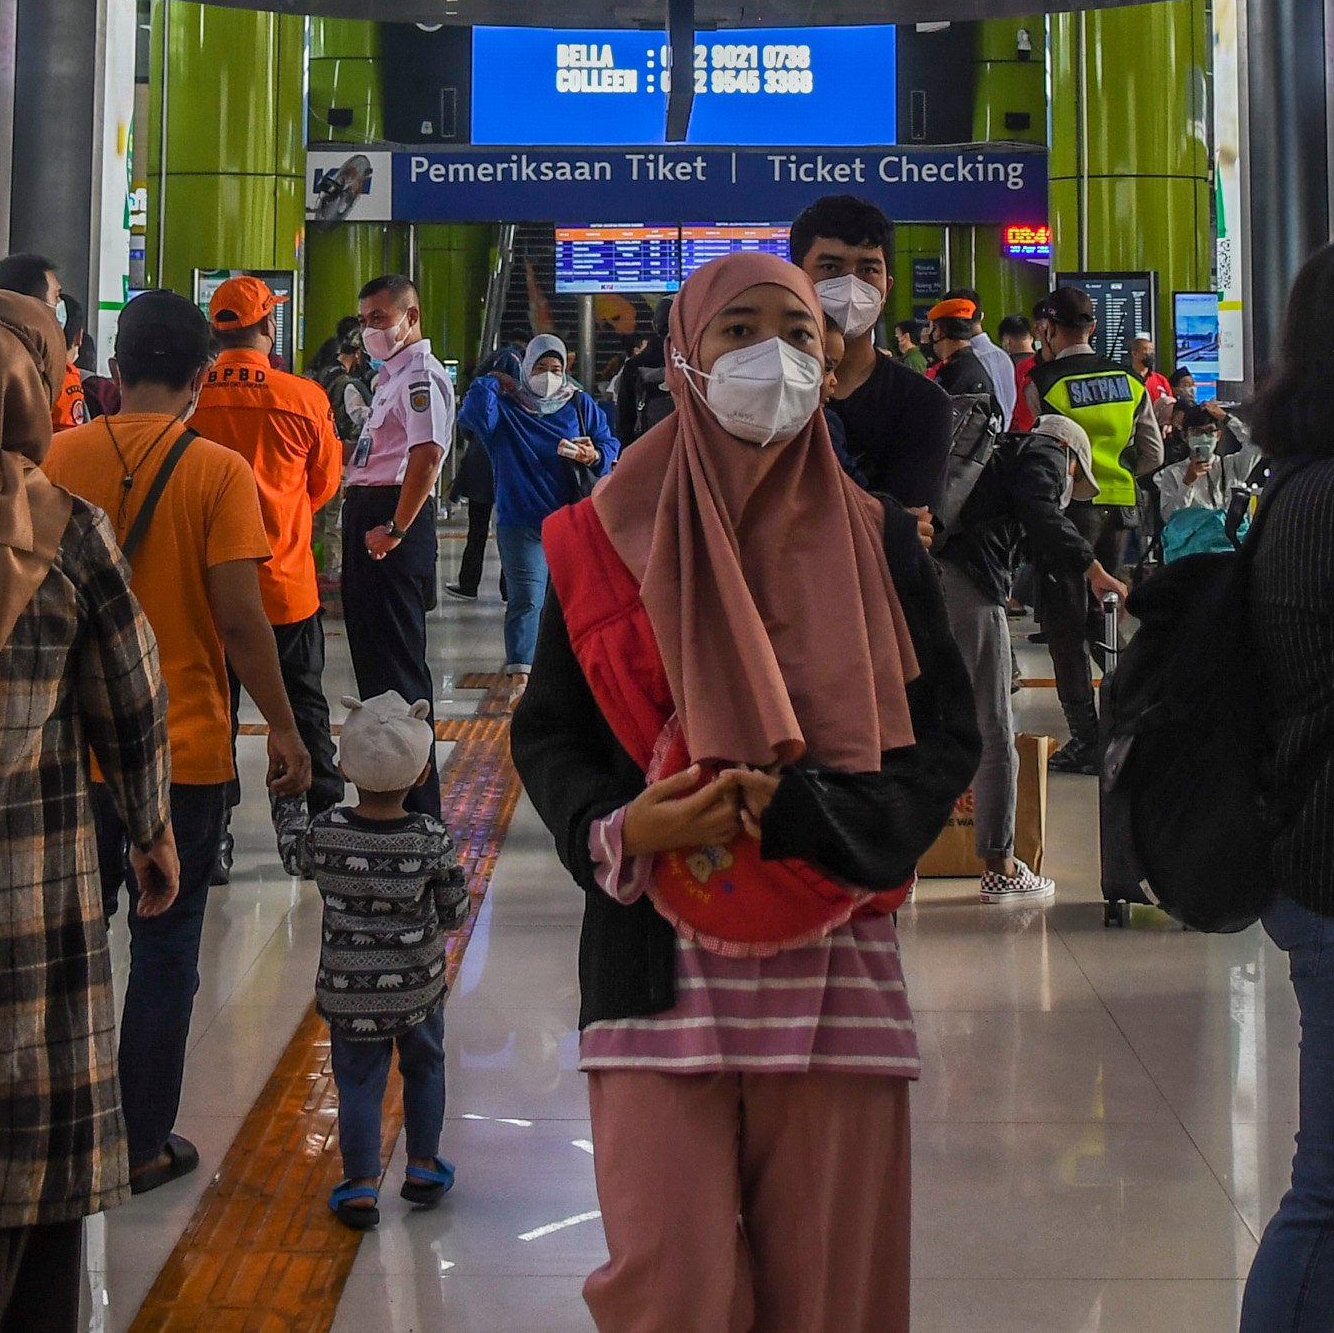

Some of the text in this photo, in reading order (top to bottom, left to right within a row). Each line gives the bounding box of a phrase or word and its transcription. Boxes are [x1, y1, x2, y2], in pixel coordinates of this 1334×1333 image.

[556, 44, 614, 67] BELLA
[556, 69, 637, 93] COLLEEN
[410, 154, 1024, 190] Pemeriksaan Tiket Ticket Checking
[1070, 375, 1131, 404] SATPAM
